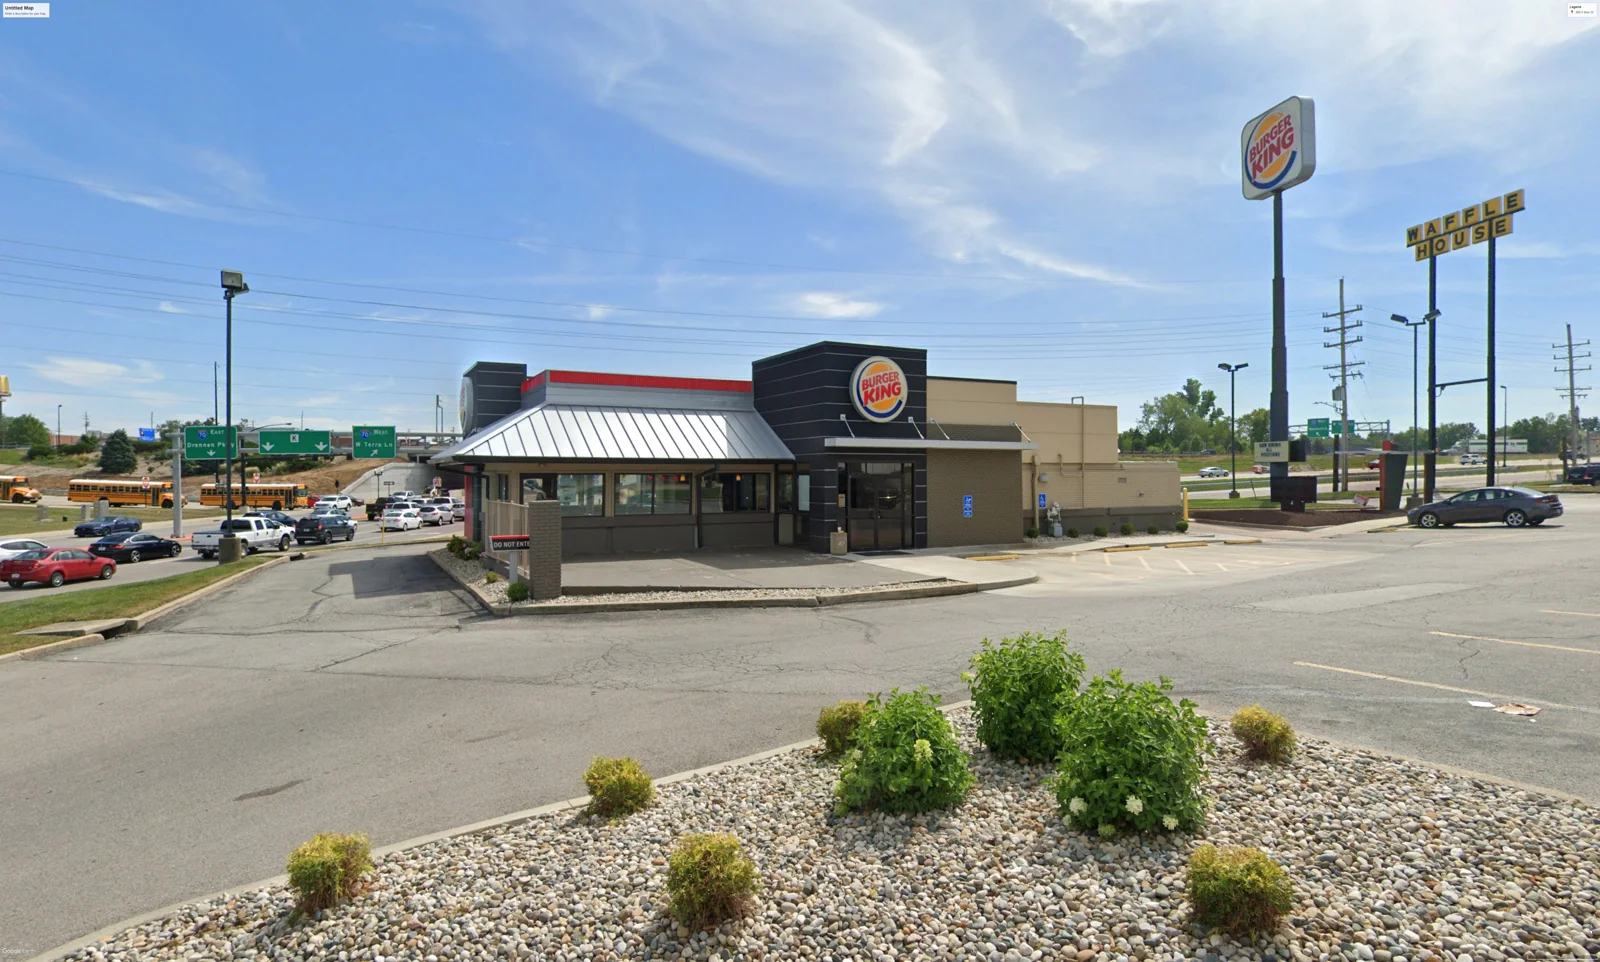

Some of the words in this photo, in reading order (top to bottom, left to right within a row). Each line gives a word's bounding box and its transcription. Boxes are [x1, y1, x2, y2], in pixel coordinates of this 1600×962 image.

[1249, 114, 1292, 164] BURGER
[1252, 127, 1294, 180] KING
[1407, 193, 1518, 242] WAFFLE
[1417, 219, 1506, 258] HOUSE
[861, 371, 899, 391] BURGER
[863, 381, 901, 406] KING
[217, 441, 235, 449] Pky
